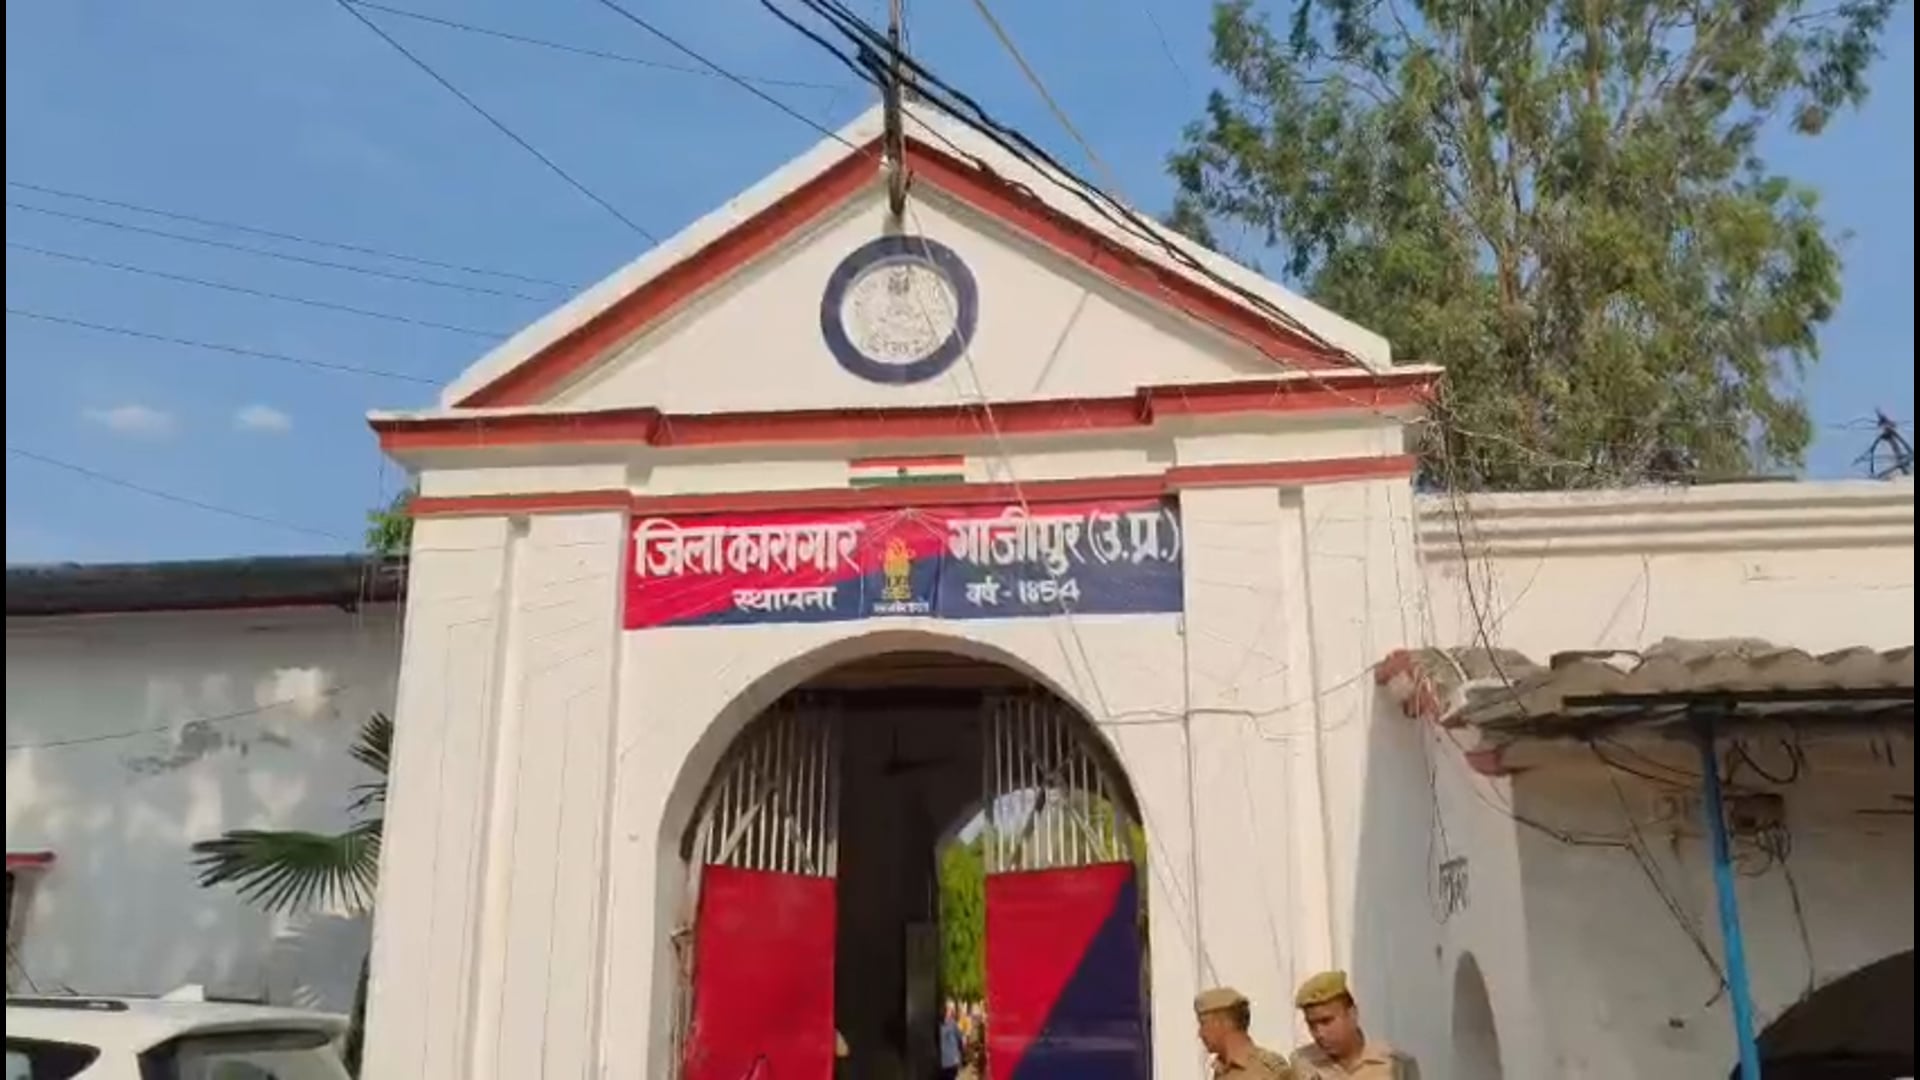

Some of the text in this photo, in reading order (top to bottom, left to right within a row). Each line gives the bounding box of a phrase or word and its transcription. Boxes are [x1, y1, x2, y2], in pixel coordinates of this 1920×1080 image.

[946, 506, 1085, 575] गाजीपुर
[1088, 507, 1180, 565] (उ.प्र.)
[732, 586, 837, 611] स्थापना
